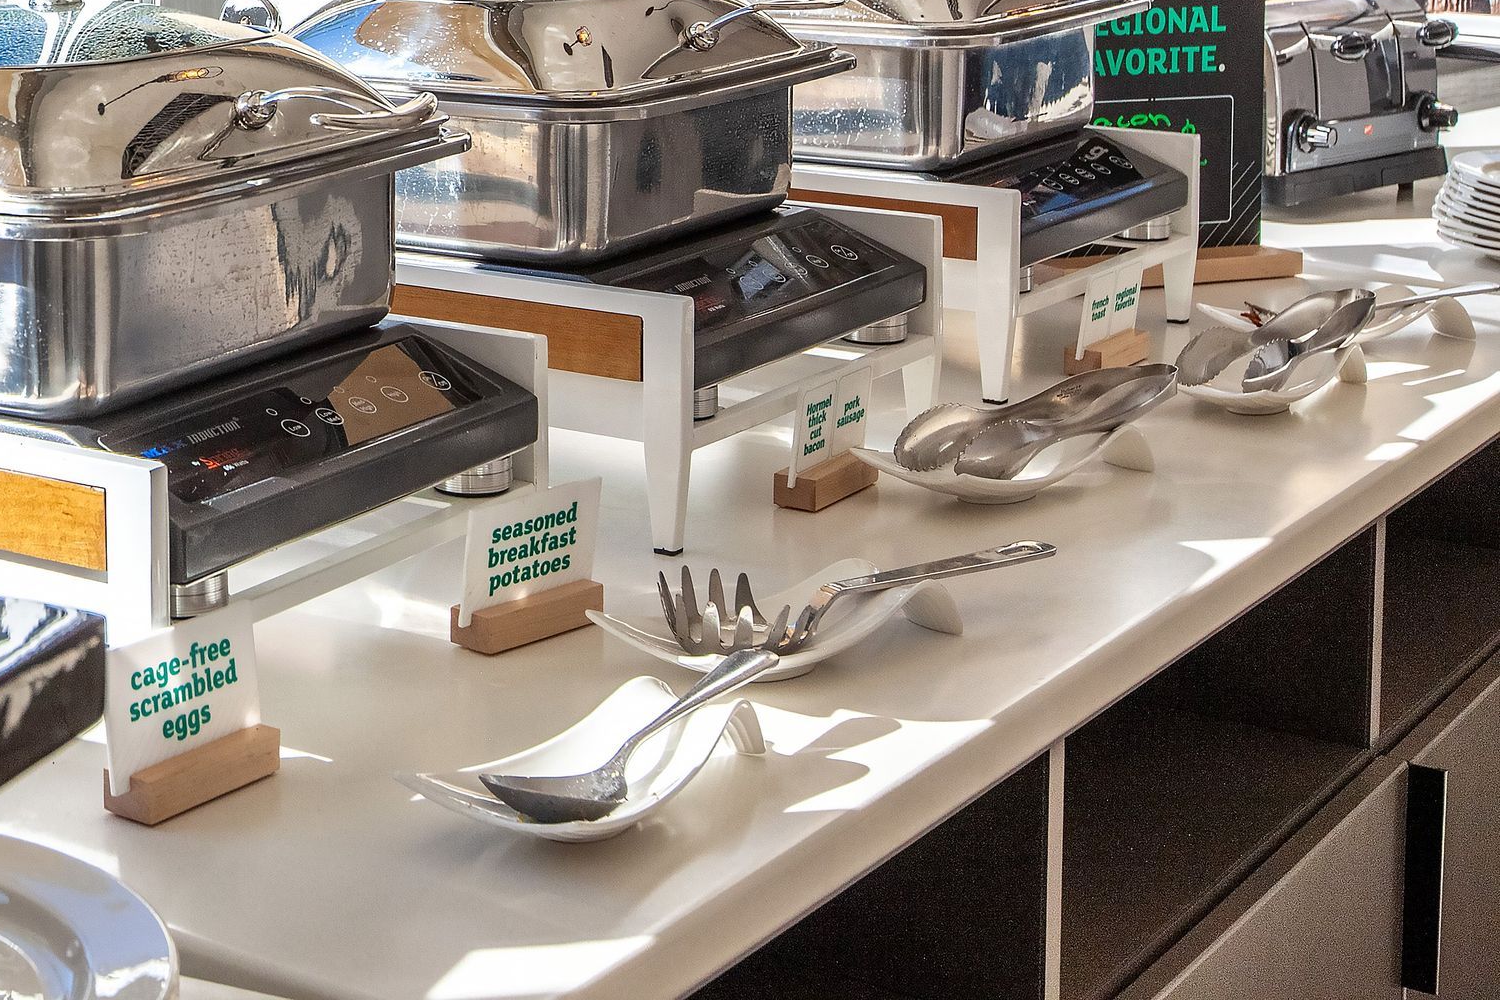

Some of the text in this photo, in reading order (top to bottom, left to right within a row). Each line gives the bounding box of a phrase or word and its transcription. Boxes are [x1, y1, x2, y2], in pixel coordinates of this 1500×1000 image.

[1096, 5, 1226, 37] EGIONAL
[1095, 44, 1226, 77] AVORITE.
[1091, 295, 1110, 311] french
[1115, 283, 1138, 303] regional
[1091, 307, 1107, 322] toast
[1114, 296, 1136, 313] favorite
[806, 394, 832, 416] Hormel
[844, 395, 861, 416] pork
[808, 410, 827, 429] thick
[836, 408, 865, 429] sausage
[809, 425, 822, 440] cut
[803, 438, 825, 456] bacon
[491, 501, 578, 545] seasoned
[487, 526, 577, 569] breakfast
[489, 554, 571, 597] potatoes
[130, 638, 231, 691] cage-free
[129, 657, 238, 722] scrambled
[162, 704, 211, 741] eggs
